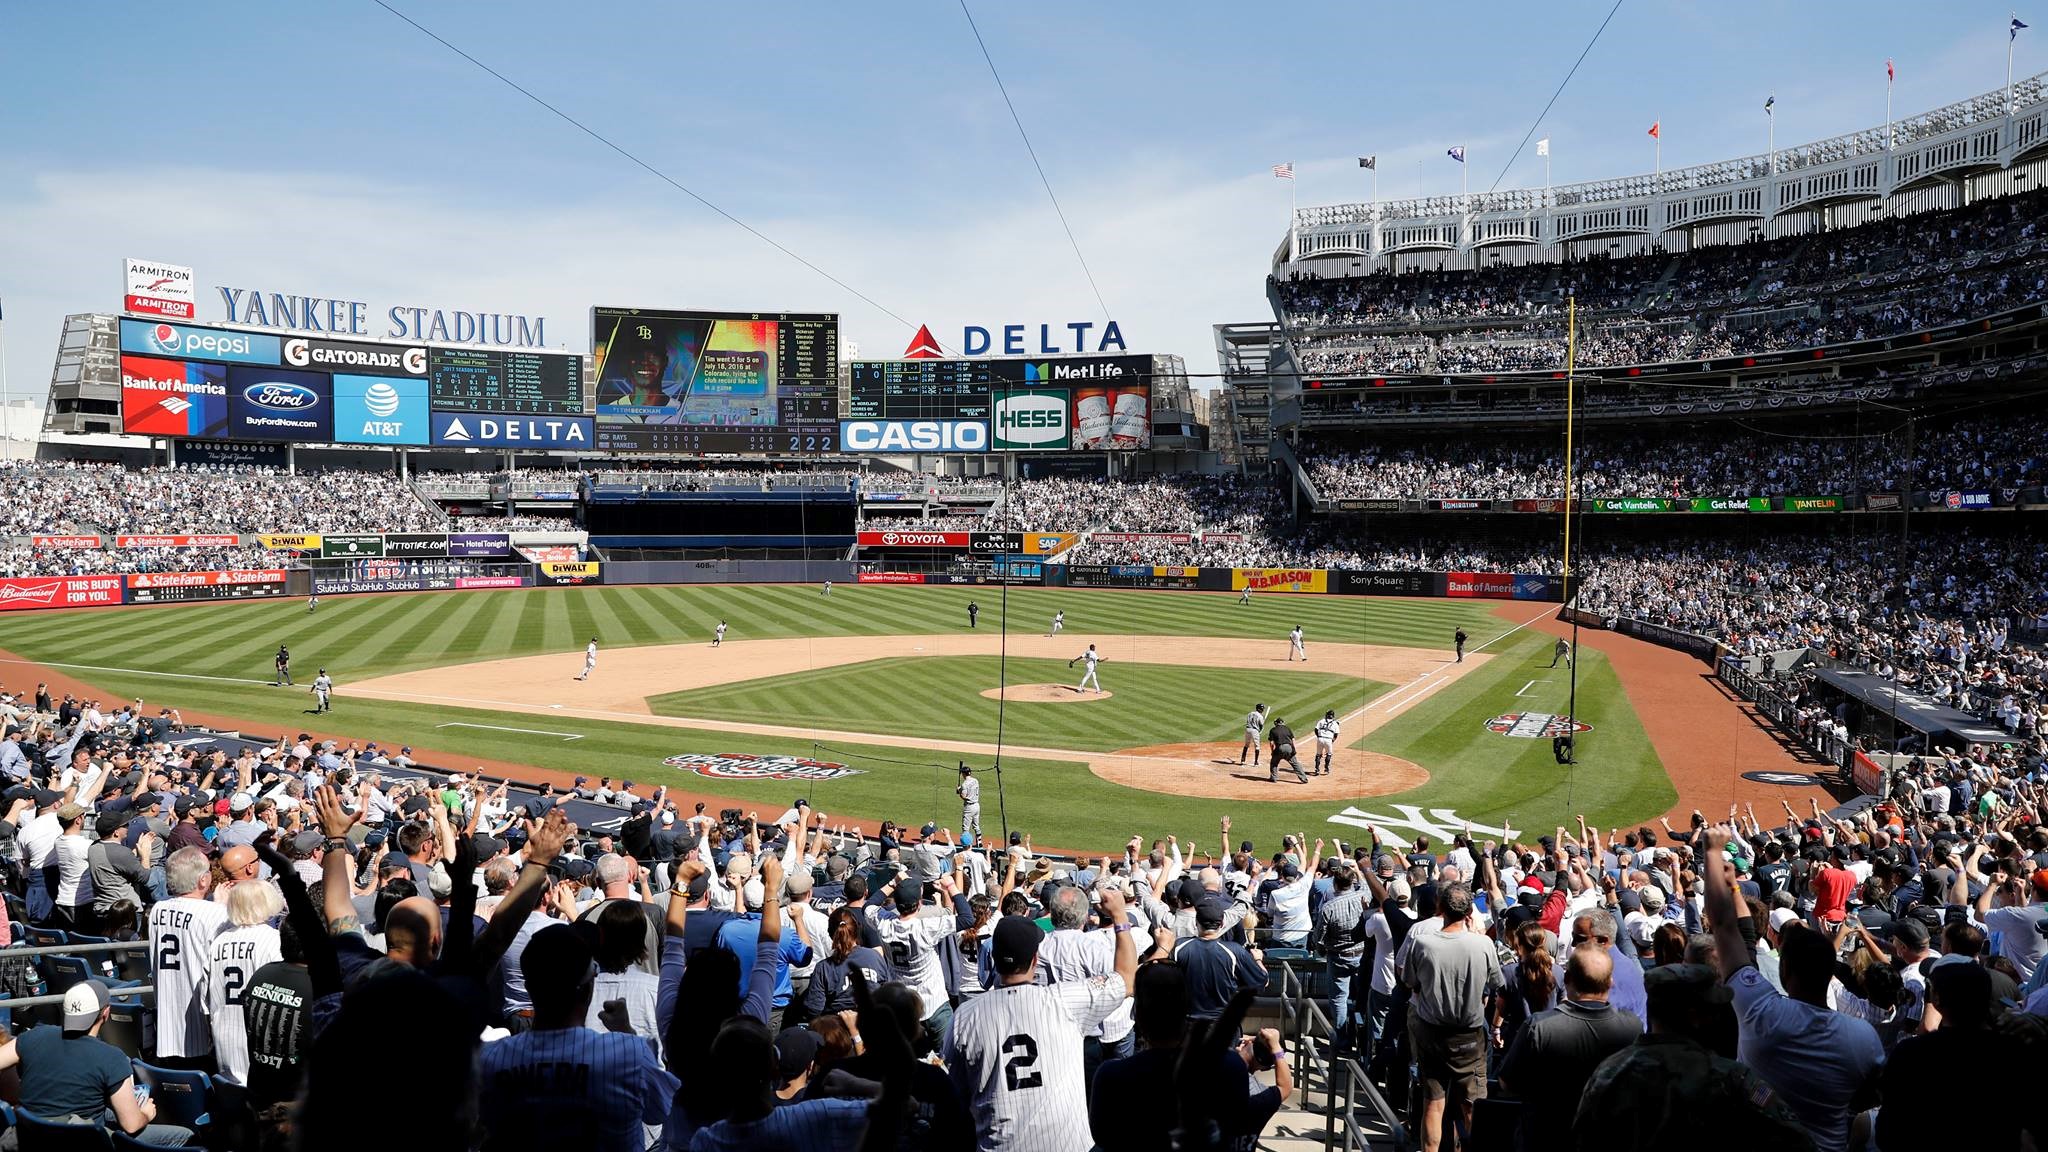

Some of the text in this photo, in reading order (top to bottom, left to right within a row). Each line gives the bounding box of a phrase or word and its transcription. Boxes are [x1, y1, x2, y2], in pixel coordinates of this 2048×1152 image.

[130, 265, 190, 280] ARMITRON
[134, 297, 189, 312] ARMITRON
[215, 286, 546, 348] YANKEE STADIUM
[186, 334, 250, 357] pepsi
[963, 321, 1127, 356] DELTA
[311, 346, 400, 369] GATORADE
[856, 370, 880, 378] 1 0
[1054, 362, 1123, 380] MetLife
[123, 375, 226, 396] Bank of America
[259, 383, 304, 407] Ford
[246, 416, 318, 429] BuyFordNow.com
[1000, 410, 1063, 428] HESS
[362, 420, 403, 436] AT&T
[480, 420, 585, 441] DELTA
[790, 436, 830, 450] 2 2 2
[846, 422, 987, 450] CASIO
[1606, 501, 1660, 510] Get Vantelin.
[1711, 500, 1750, 510] Get Relief.
[1794, 500, 1836, 510] VANTELIN
[386, 540, 447, 550] NITTOTIRE.COM
[900, 534, 946, 544] TOYOTA
[1039, 538, 1057, 549] SAP
[66, 580, 120, 591] THIS BUD'S
[317, 580, 420, 594] StubHub StubHub StubHub
[1350, 576, 1371, 586] Sony
[1373, 576, 1404, 586] Square
[1450, 582, 1522, 593] Bank of America
[2, 588, 54, 599] Budweiser
[67, 592, 110, 602] FOR YOU.
[1776, 878, 1786, 890] 7
[153, 909, 193, 930] JETER
[160, 934, 180, 970] 2
[214, 942, 256, 962] JETER
[224, 966, 244, 1006] 2
[842, 967, 878, 990] JER
[252, 986, 303, 1008] SENIORS
[71, 1001, 82, 1013] NY
[253, 1051, 283, 1070] 2017
[1002, 1033, 1042, 1092] 2
